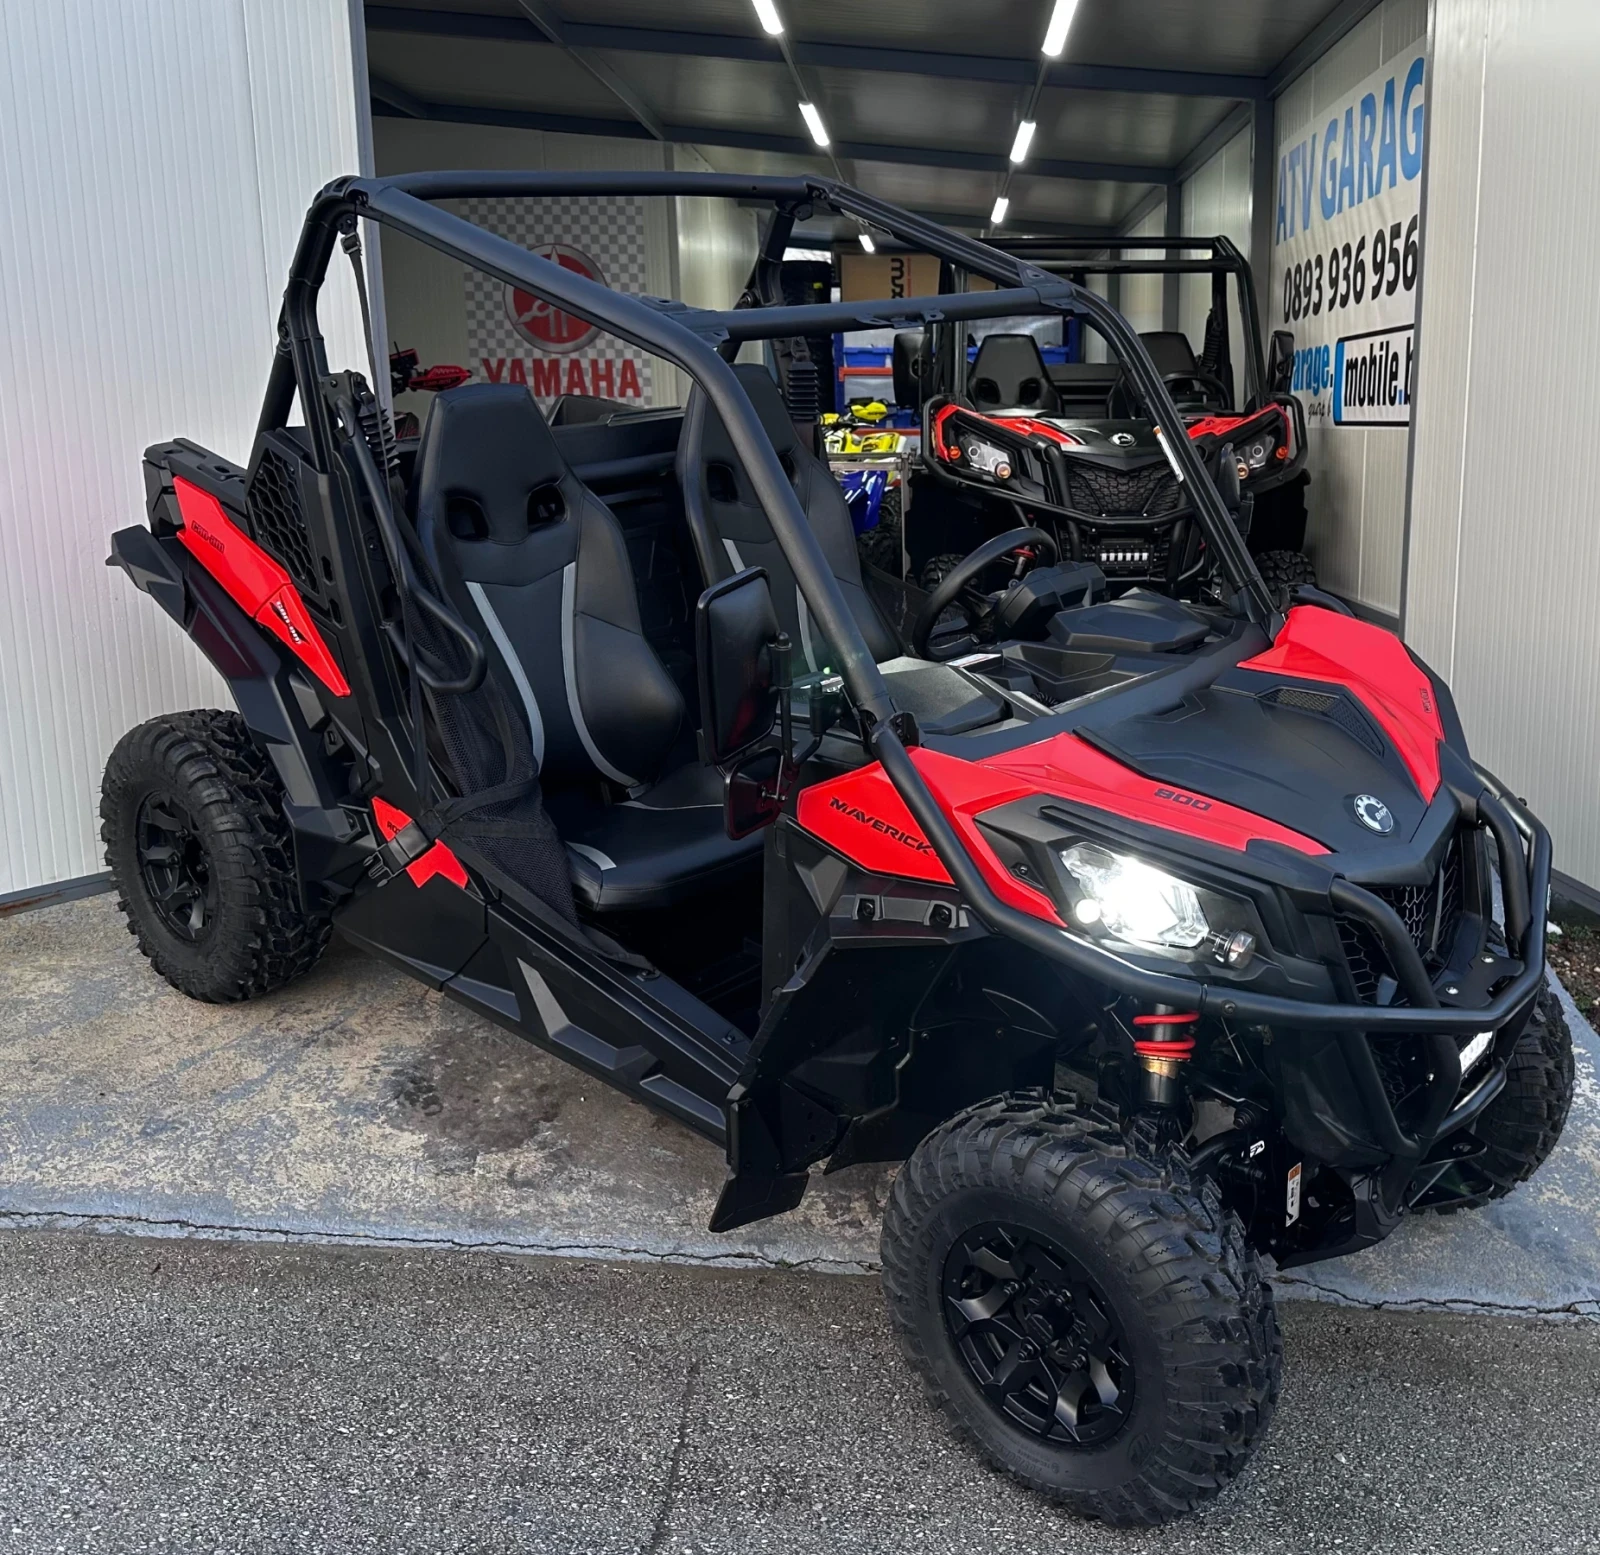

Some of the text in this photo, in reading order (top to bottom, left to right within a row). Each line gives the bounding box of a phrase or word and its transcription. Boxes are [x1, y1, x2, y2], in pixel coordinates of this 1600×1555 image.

[1276, 57, 1424, 246] ATV GARAG
[1283, 214, 1418, 324] 0893 936 956
[482, 358, 641, 397] YAMAHA
[829, 796, 933, 856] MAVERICK
[1154, 788, 1212, 811] 800
